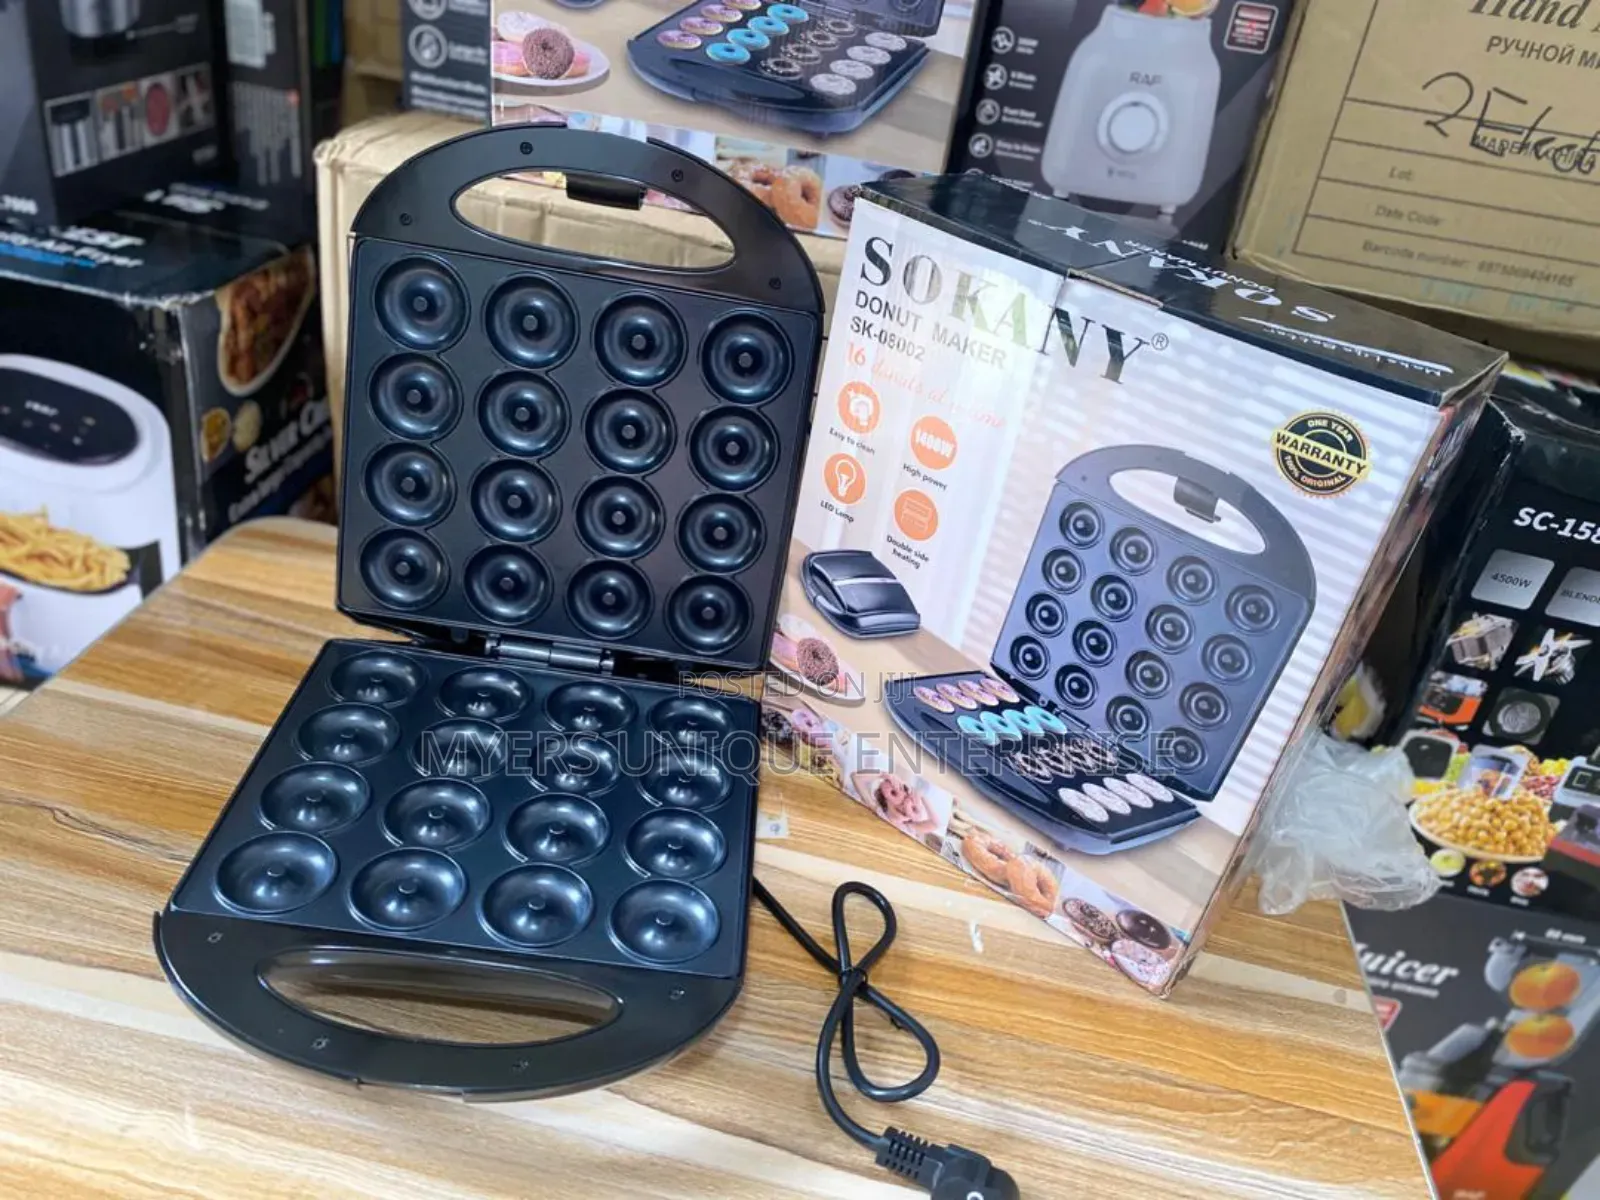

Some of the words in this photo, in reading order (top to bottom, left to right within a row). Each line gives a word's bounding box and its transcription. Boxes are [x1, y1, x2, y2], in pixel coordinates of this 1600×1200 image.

[1486, 35, 1575, 65] РУЧНОЙ
[860, 236, 1150, 385] SOKANY
[850, 316, 926, 362] SK-08002
[855, 290, 924, 331] DONUT
[931, 317, 1009, 370] MAKER
[829, 427, 845, 442] Easy
[856, 439, 876, 455] clean
[1307, 419, 1328, 428] ONE
[1332, 420, 1354, 442] YEAR
[1276, 431, 1366, 474] WARRANTY
[903, 463, 921, 479] High
[922, 474, 948, 491] power
[820, 499, 834, 512] LED
[886, 534, 913, 553] Double
[914, 549, 930, 563] side
[892, 548, 921, 570] heating
[1491, 572, 1533, 589] 4500W
